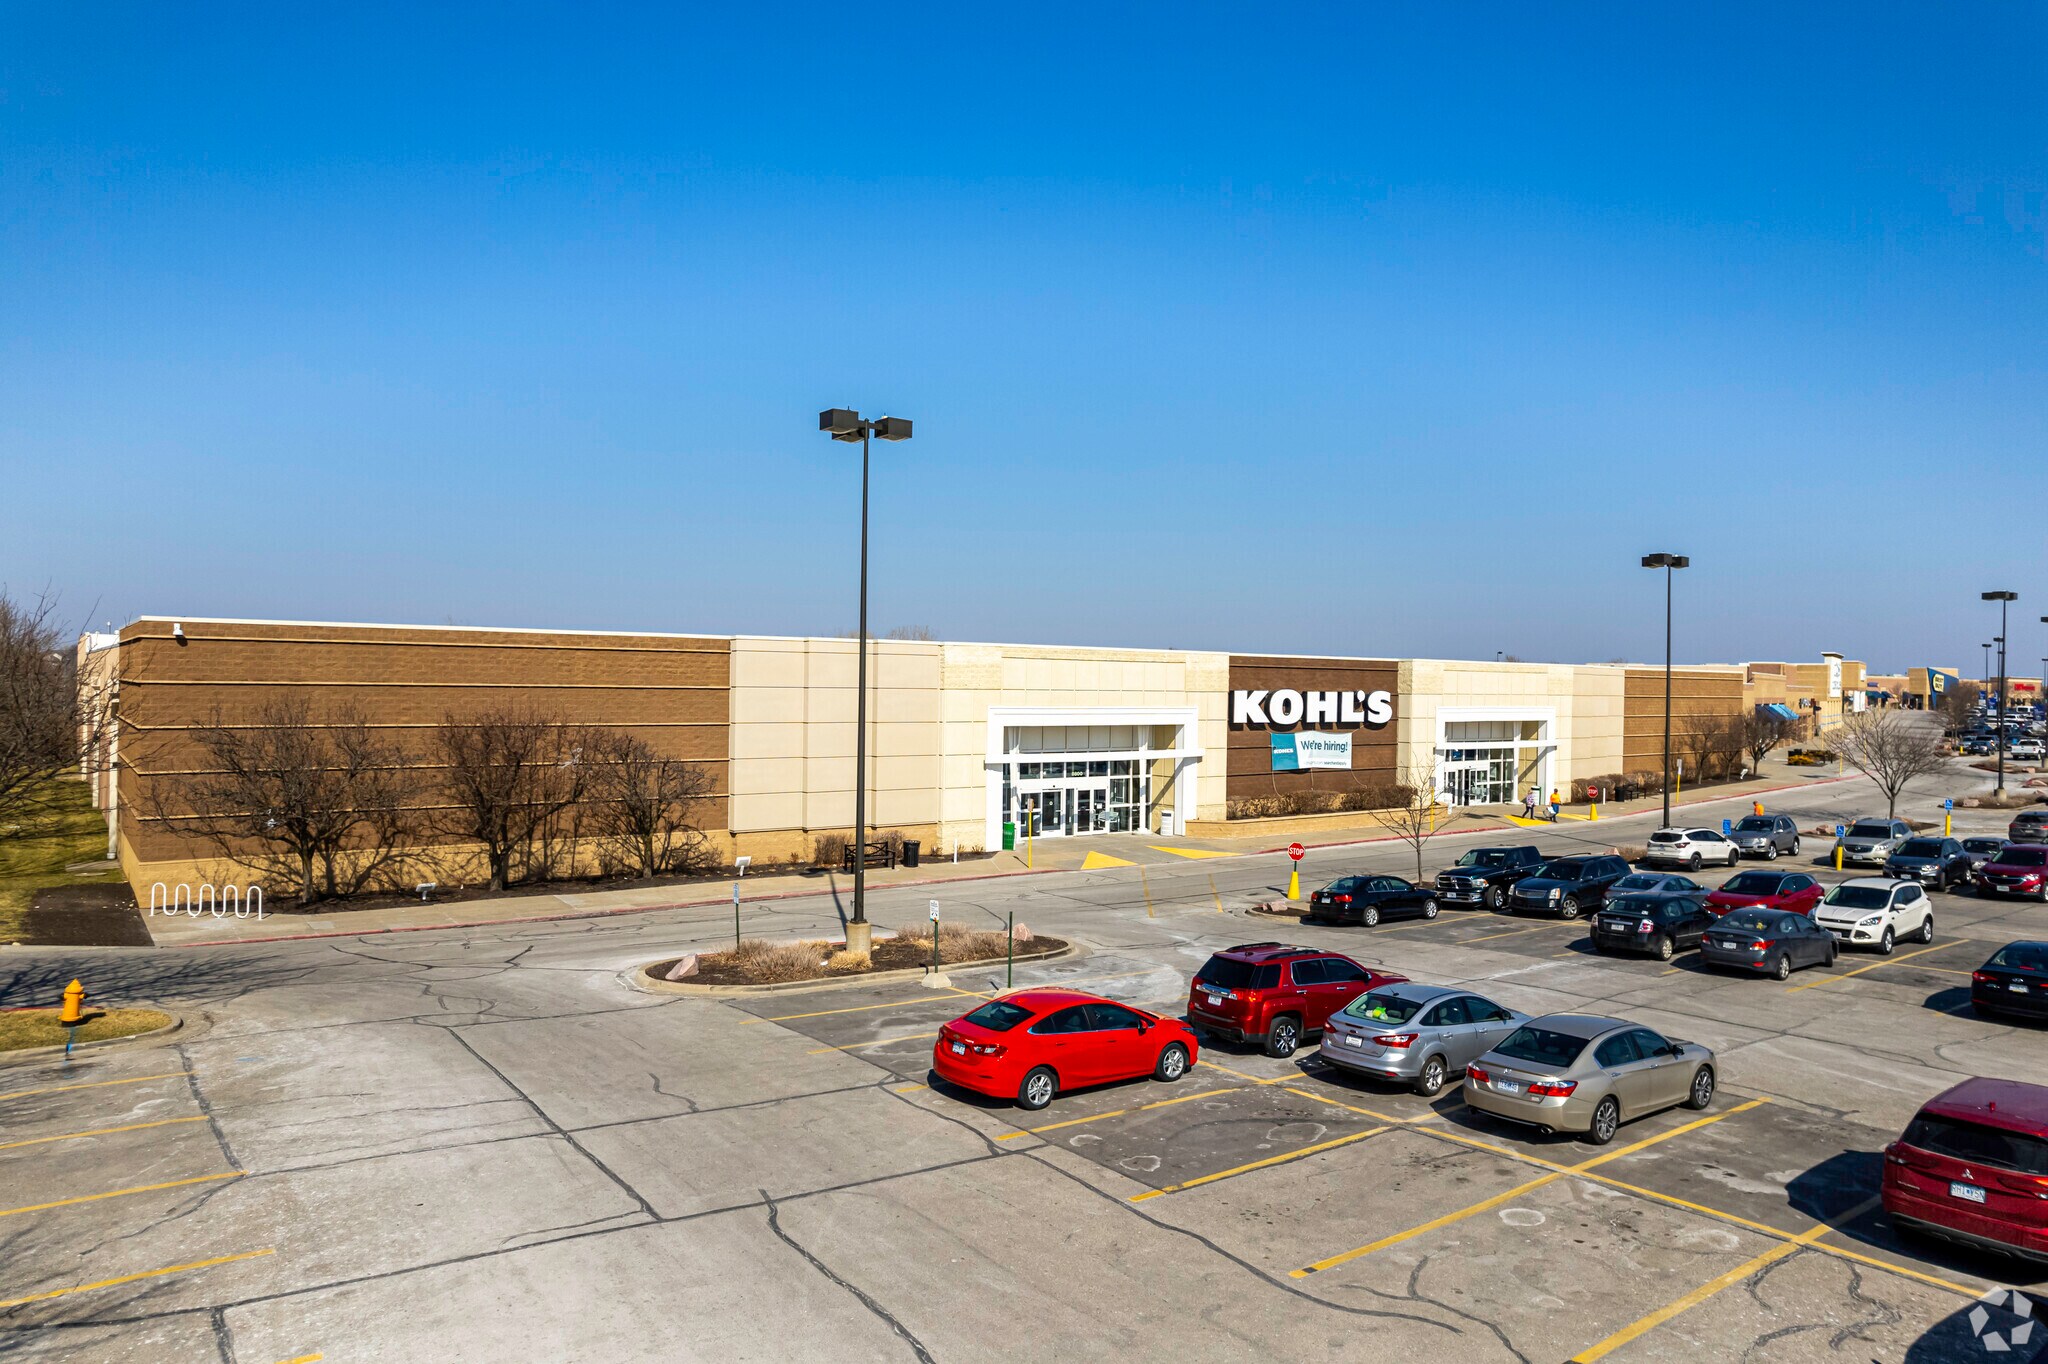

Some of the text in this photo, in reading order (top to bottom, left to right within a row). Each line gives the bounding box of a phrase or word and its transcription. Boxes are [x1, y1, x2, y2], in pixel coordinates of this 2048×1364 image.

[1233, 688, 1393, 725] KOHL'S
[1300, 740, 1348, 753] We're hiring!
[1289, 847, 1304, 856] STOP
